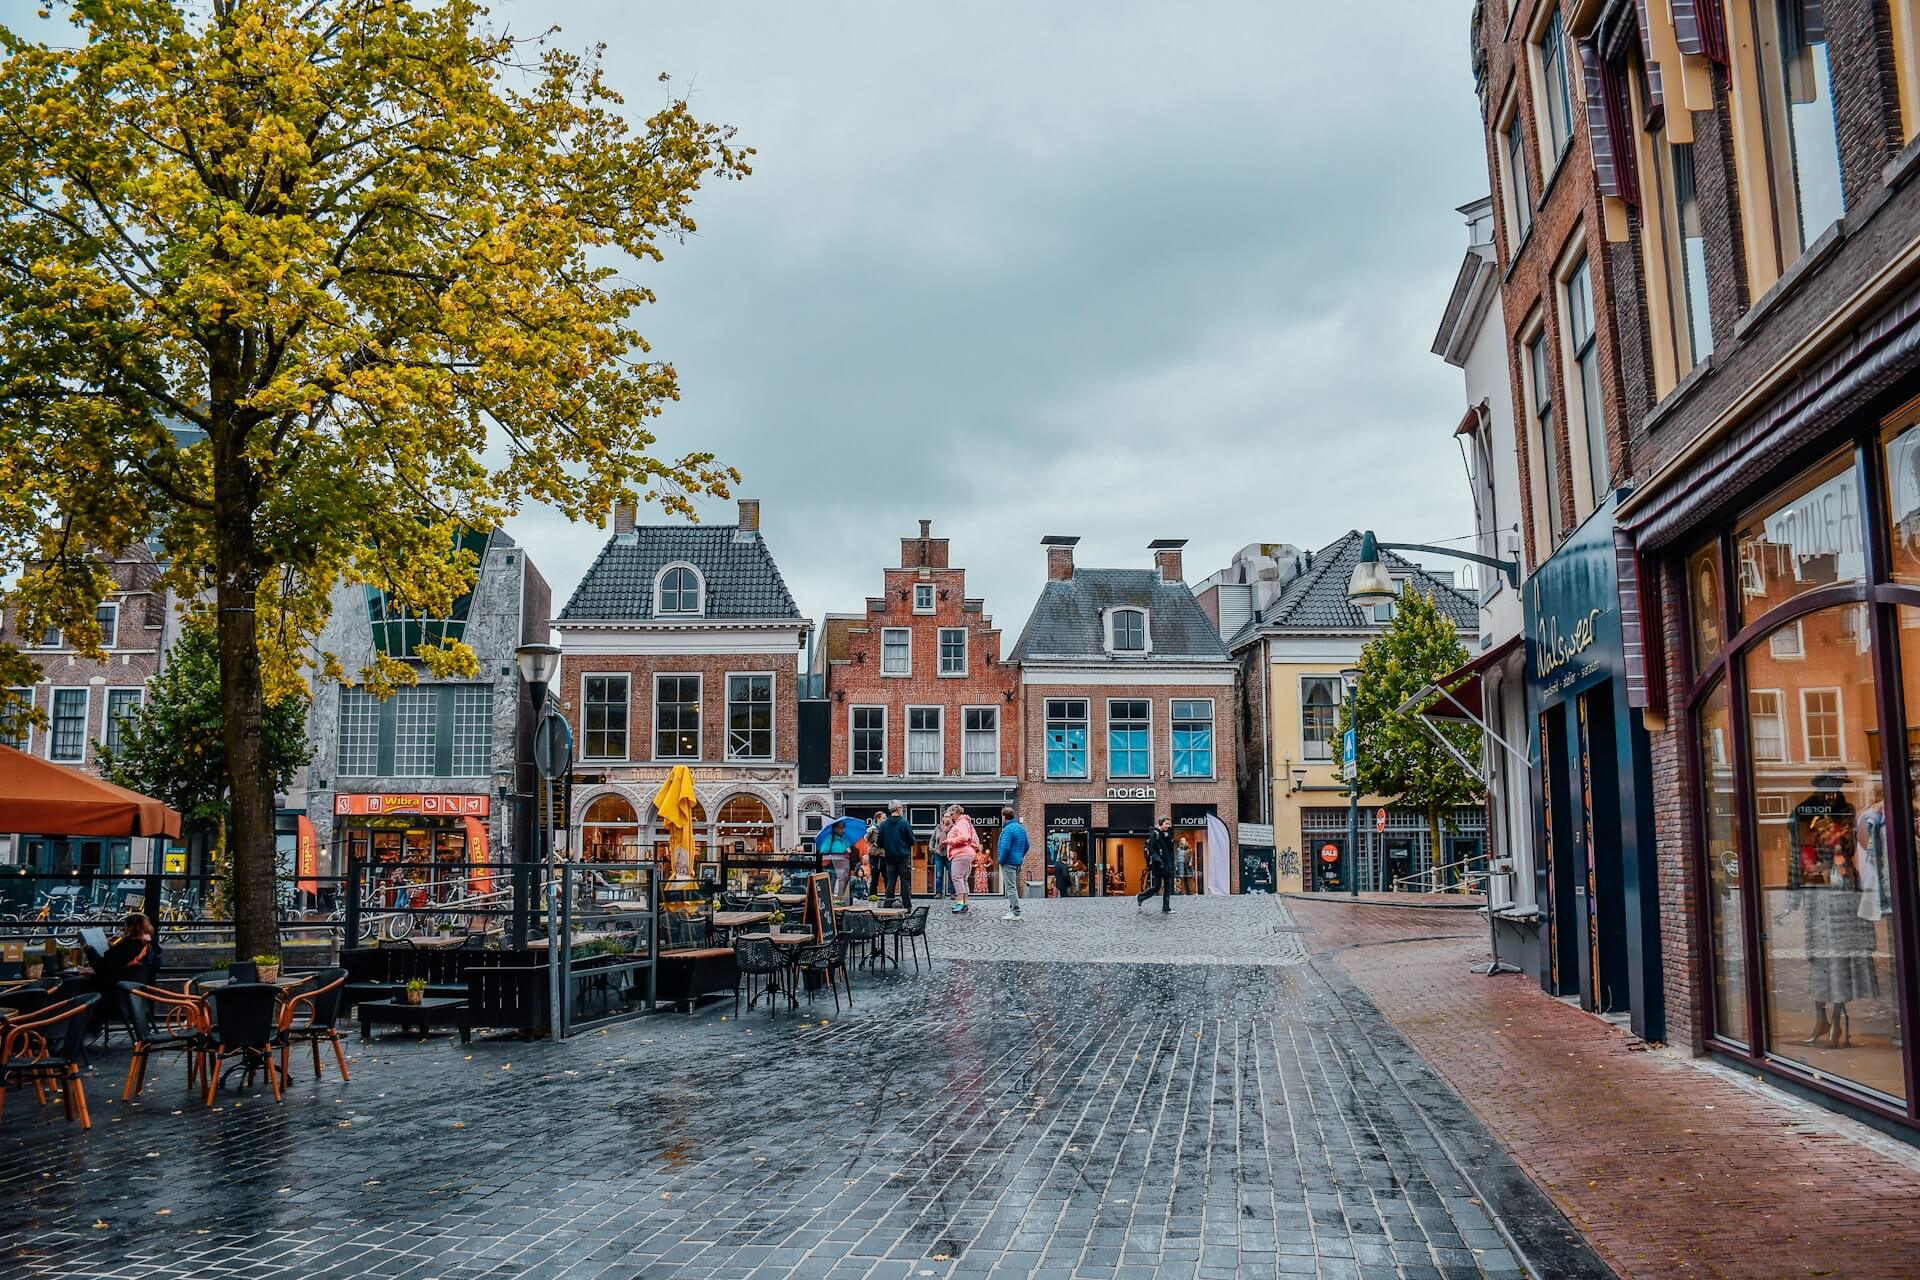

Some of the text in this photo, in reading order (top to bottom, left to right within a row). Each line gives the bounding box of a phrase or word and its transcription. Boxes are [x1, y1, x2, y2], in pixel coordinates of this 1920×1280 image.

[1106, 785, 1157, 799] norah
[384, 796, 420, 805] Wibra
[1053, 816, 1085, 826] norah
